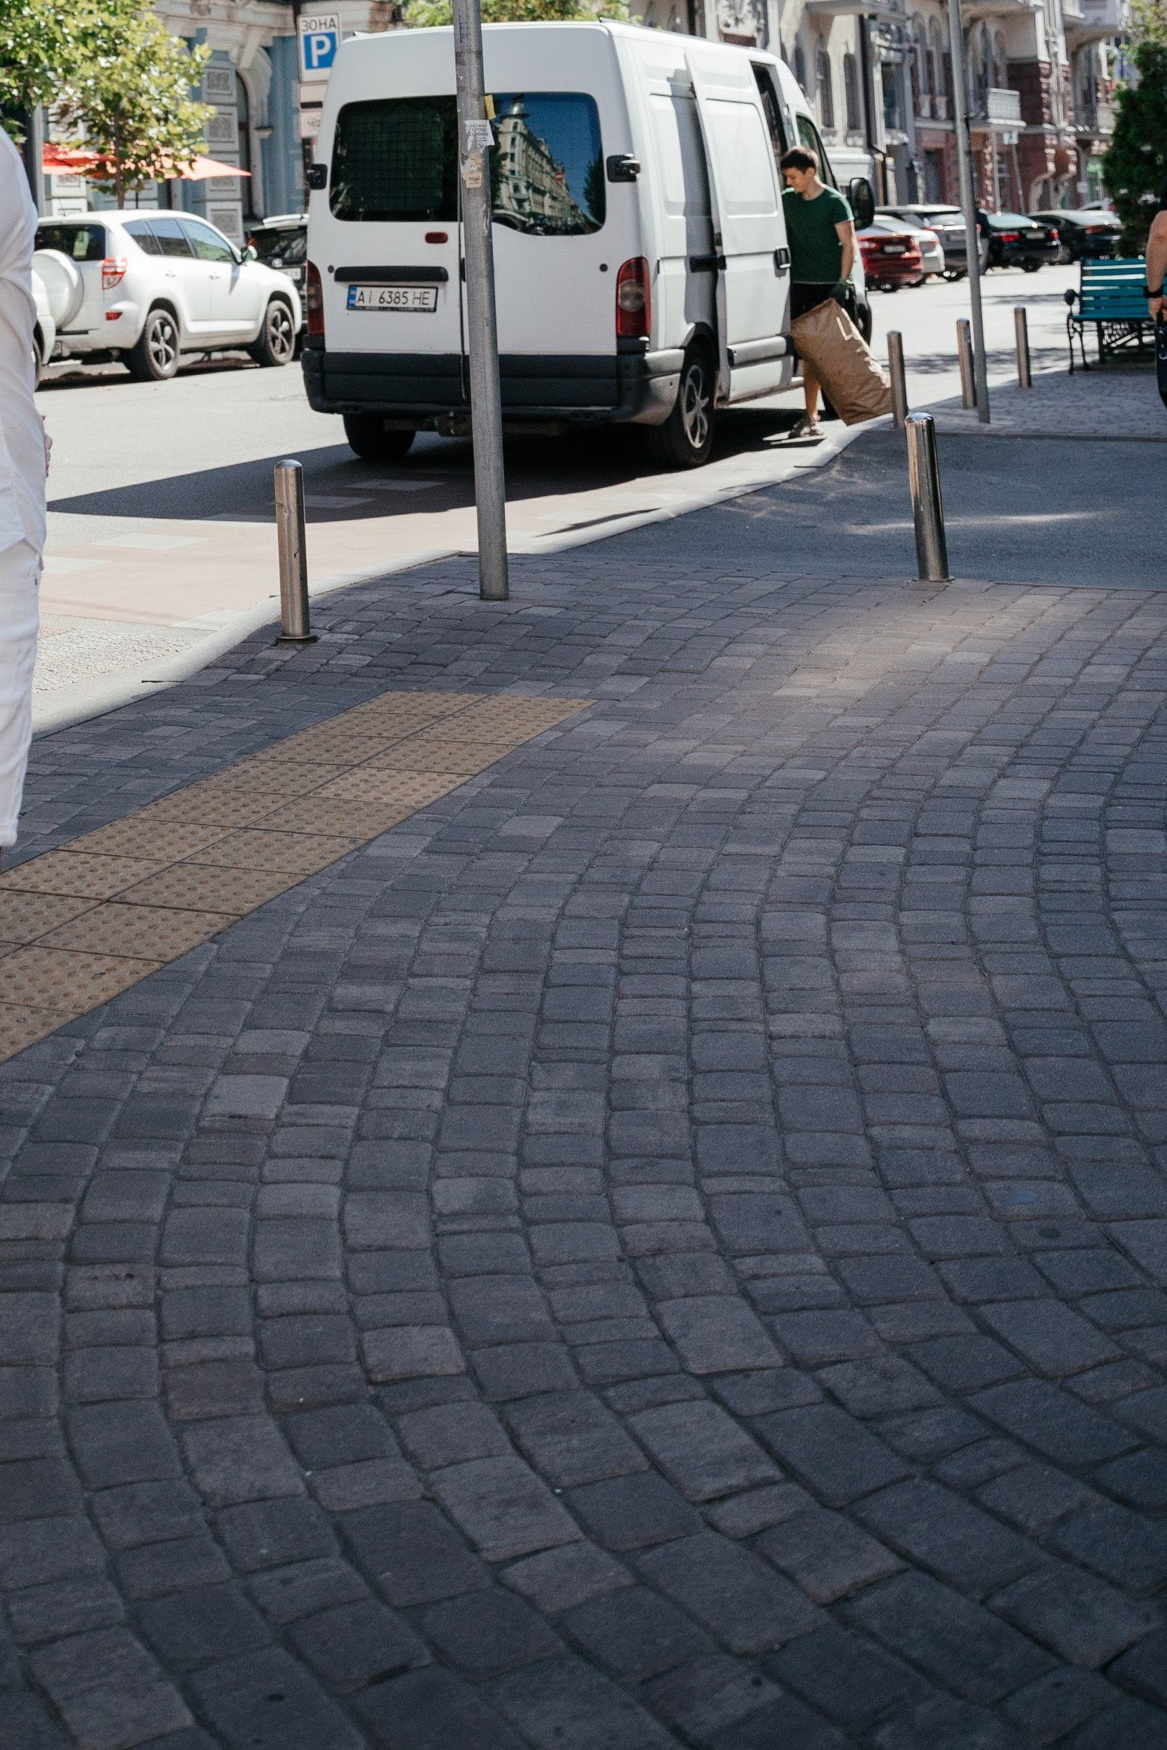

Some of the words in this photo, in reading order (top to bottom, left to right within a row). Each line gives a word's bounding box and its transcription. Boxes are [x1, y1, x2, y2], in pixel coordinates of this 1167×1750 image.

[301, 16, 337, 31] ЗОНА
[310, 34, 332, 68] P
[378, 290, 409, 305] 6385
[412, 291, 431, 306] HE
